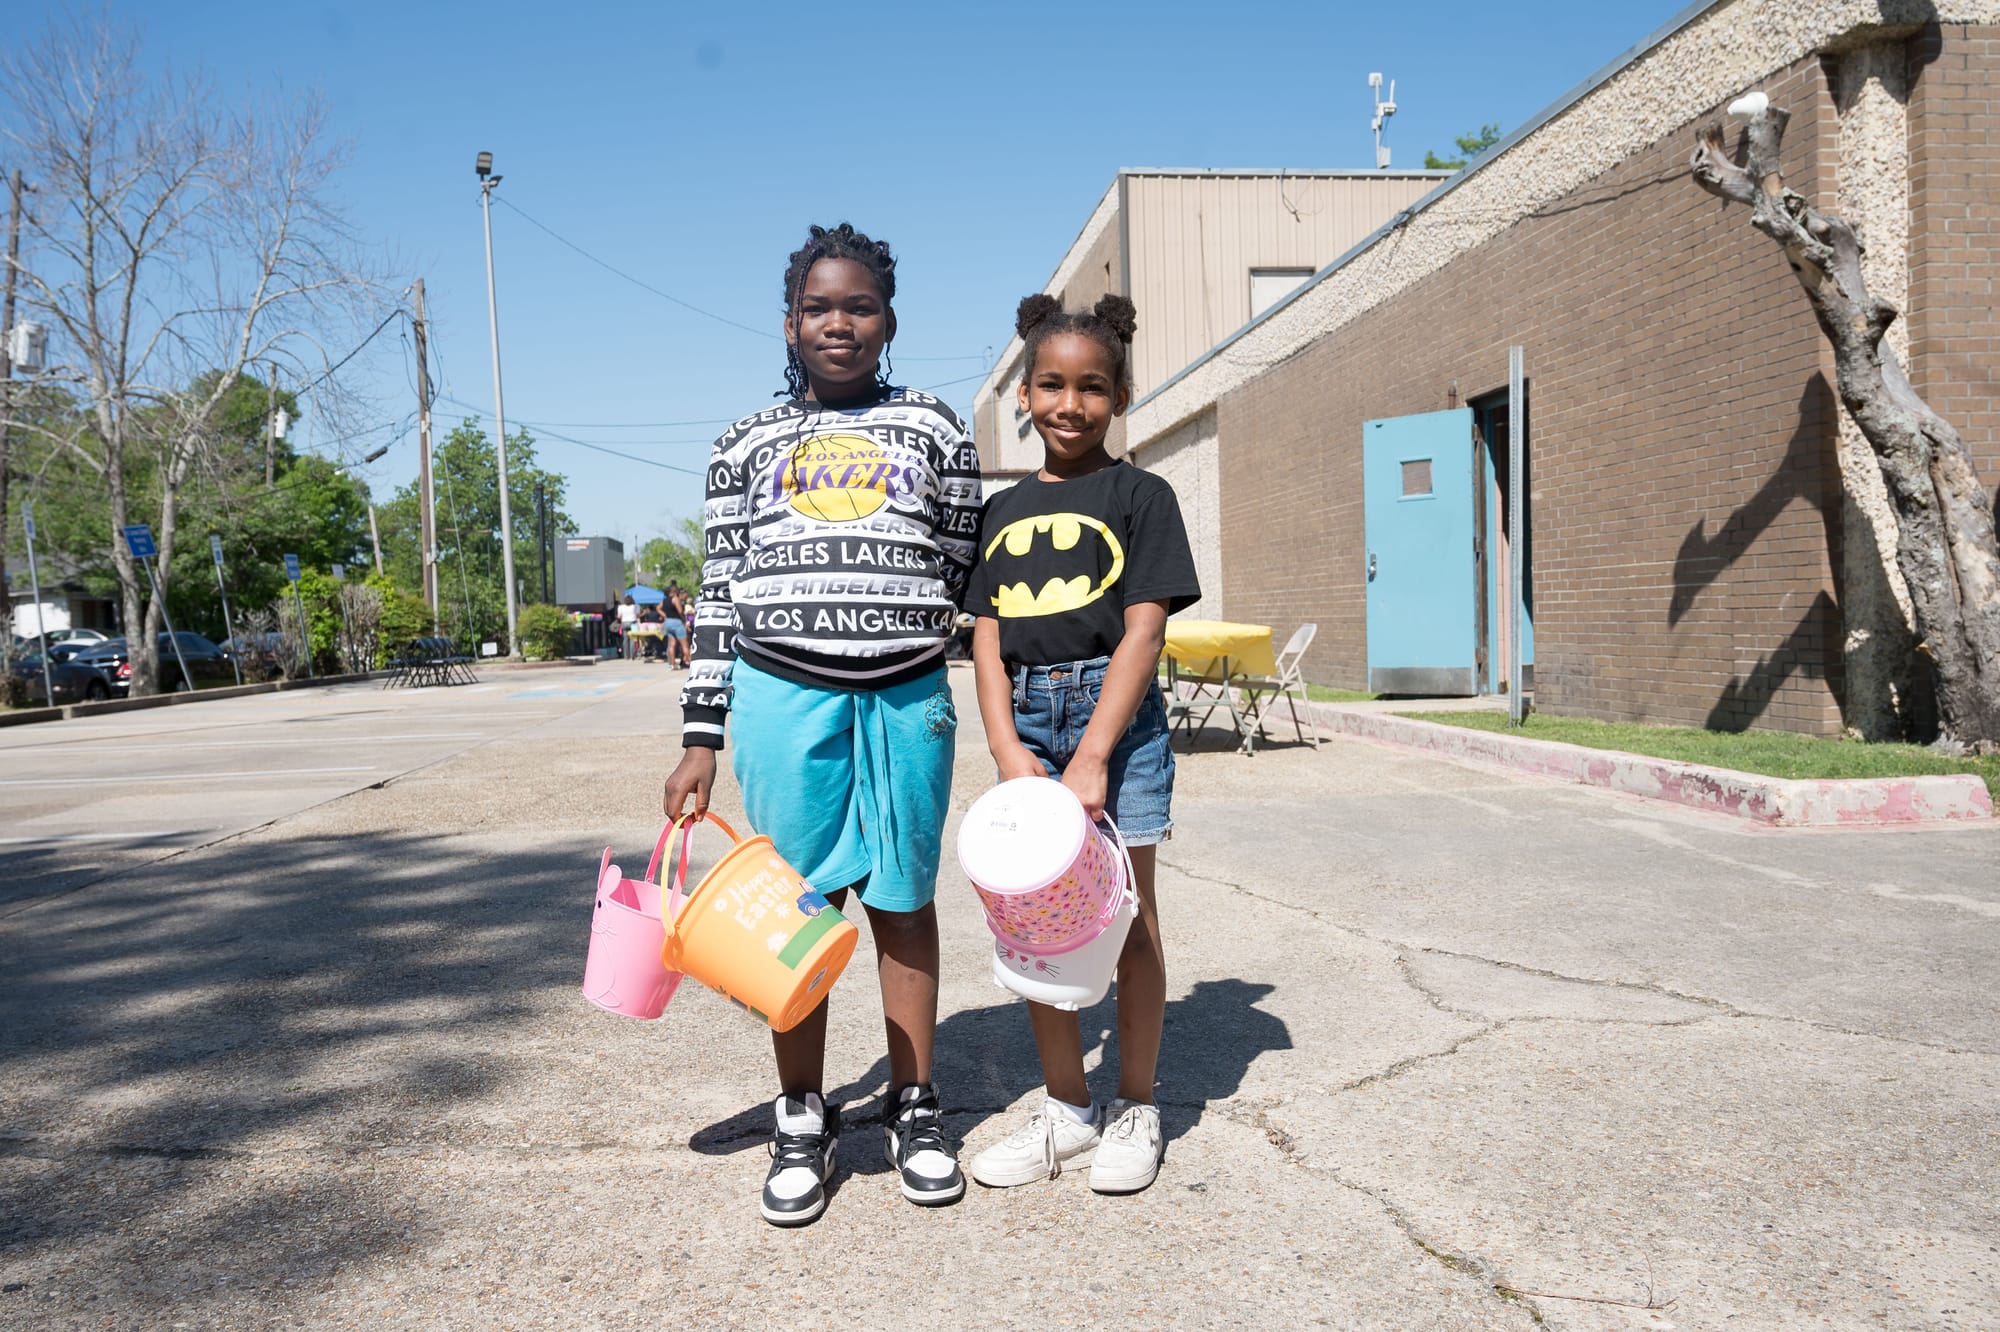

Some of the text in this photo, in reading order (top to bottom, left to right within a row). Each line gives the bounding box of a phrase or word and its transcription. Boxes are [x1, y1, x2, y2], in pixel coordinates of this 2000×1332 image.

[804, 449, 924, 467] LOS ANGELES
[763, 456, 922, 508] LAKERS
[840, 541, 927, 570] LAKERS
[742, 579, 784, 599] LOS
[790, 577, 913, 597] ANGELES
[755, 608, 804, 632] LOS
[813, 608, 926, 632] ANGELES
[734, 876, 794, 930] Easter
